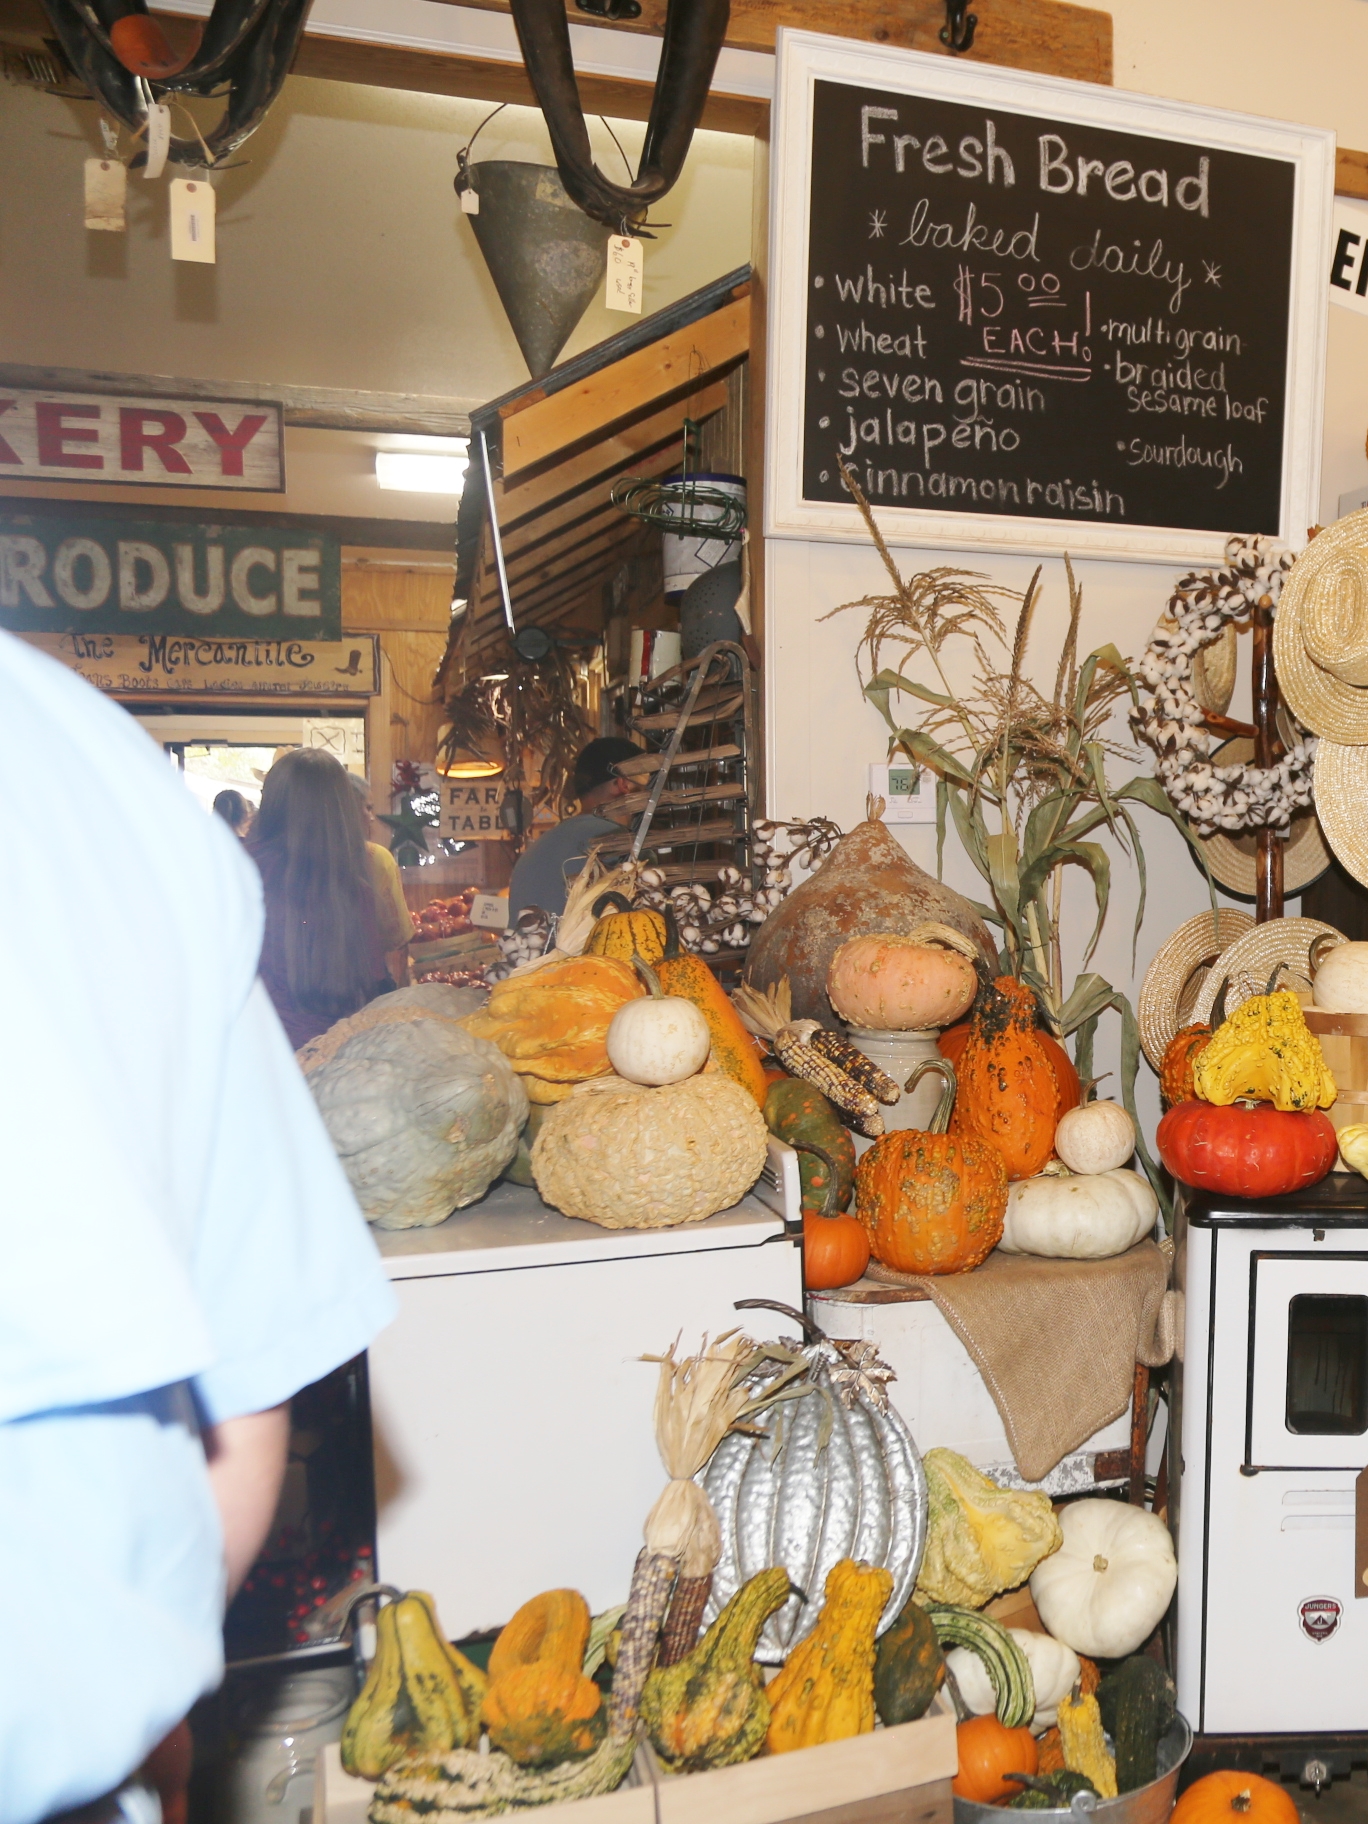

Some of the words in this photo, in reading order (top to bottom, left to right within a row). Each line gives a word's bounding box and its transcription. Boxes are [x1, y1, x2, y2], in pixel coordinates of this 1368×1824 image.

[861, 105, 1016, 187] Fresh
[1038, 134, 1210, 217] Bread
[899, 198, 1041, 263] baked
[1069, 229, 1193, 314] daily
[835, 267, 936, 309] white
[837, 324, 928, 358] wheat
[1114, 350, 1227, 392] braided
[838, 366, 943, 404] seven
[953, 378, 1045, 422] grain
[1225, 390, 1269, 424] loaf
[839, 407, 1021, 469] jalapeño
[1026, 481, 1126, 516] raisin
[60, 632, 114, 661] The
[138, 633, 315, 675] Mercantile
[117, 673, 159, 690] Boots
[449, 787, 501, 805] FAR
[891, 777, 909, 791] 76
[448, 815, 506, 831] TABL
[1304, 1602, 1337, 1611] JUNGERS
